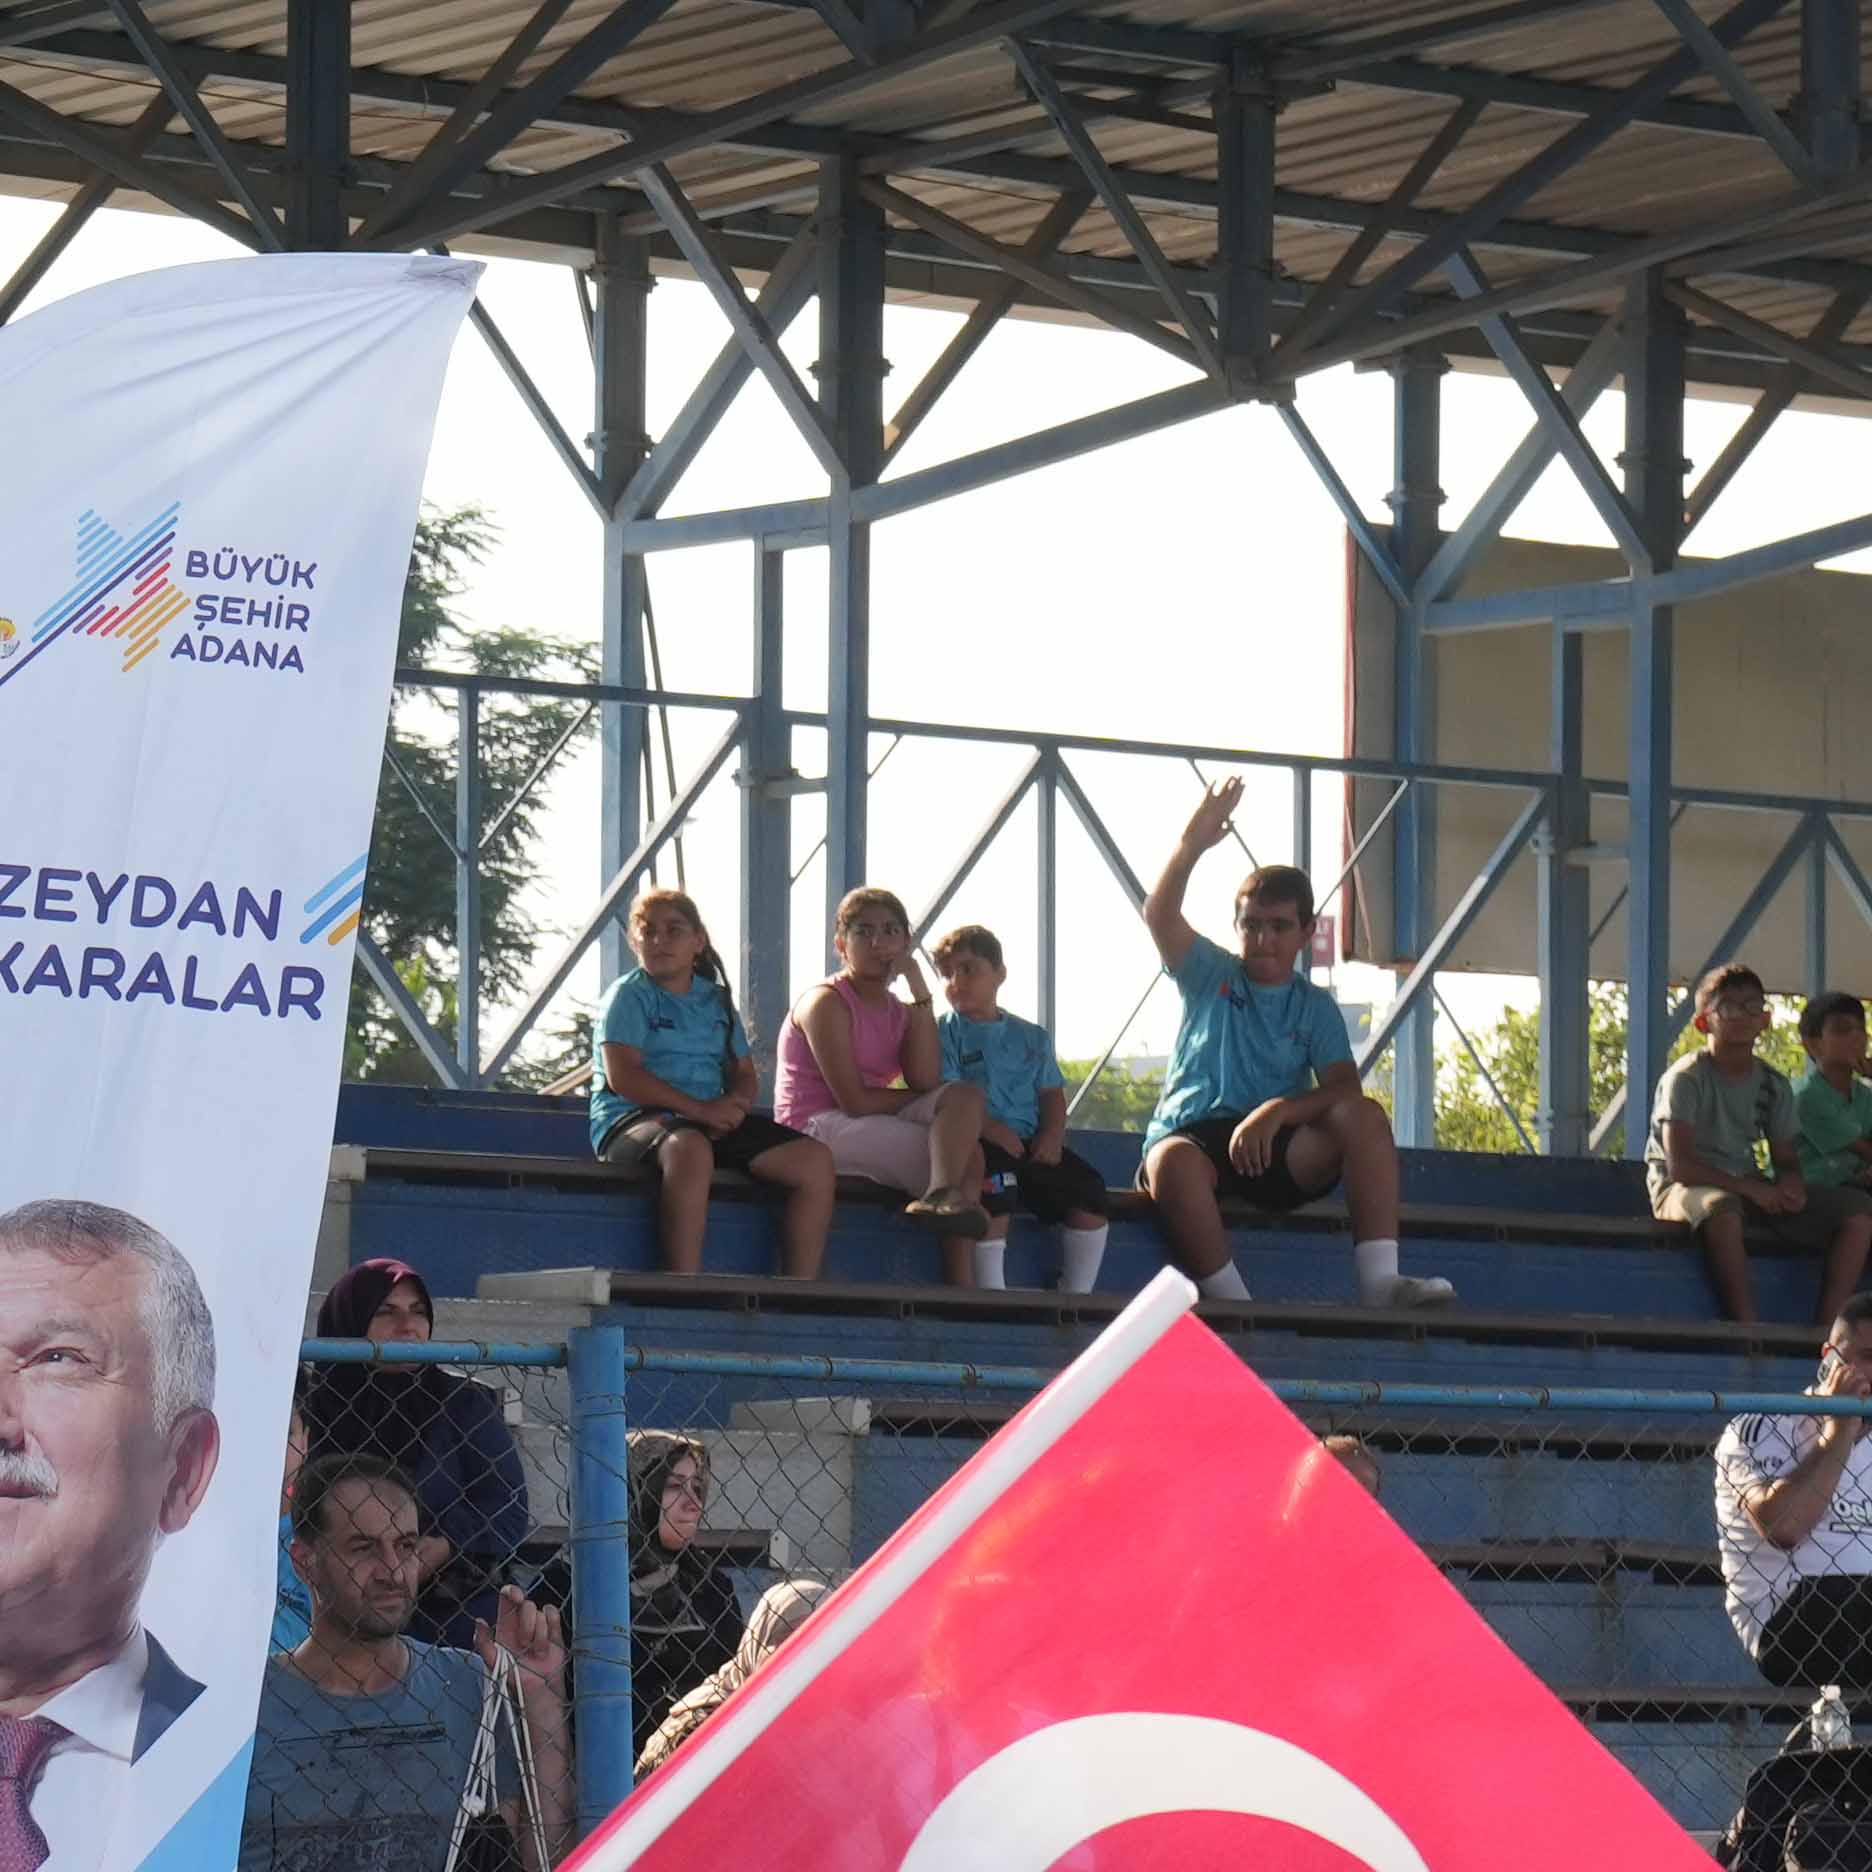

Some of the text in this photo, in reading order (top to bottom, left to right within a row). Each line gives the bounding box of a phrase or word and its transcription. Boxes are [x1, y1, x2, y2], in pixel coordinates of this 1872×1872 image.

[186, 548, 317, 590] BÜYÜK
[193, 594, 311, 633] ŞEHİR
[170, 634, 305, 674] ADANA
